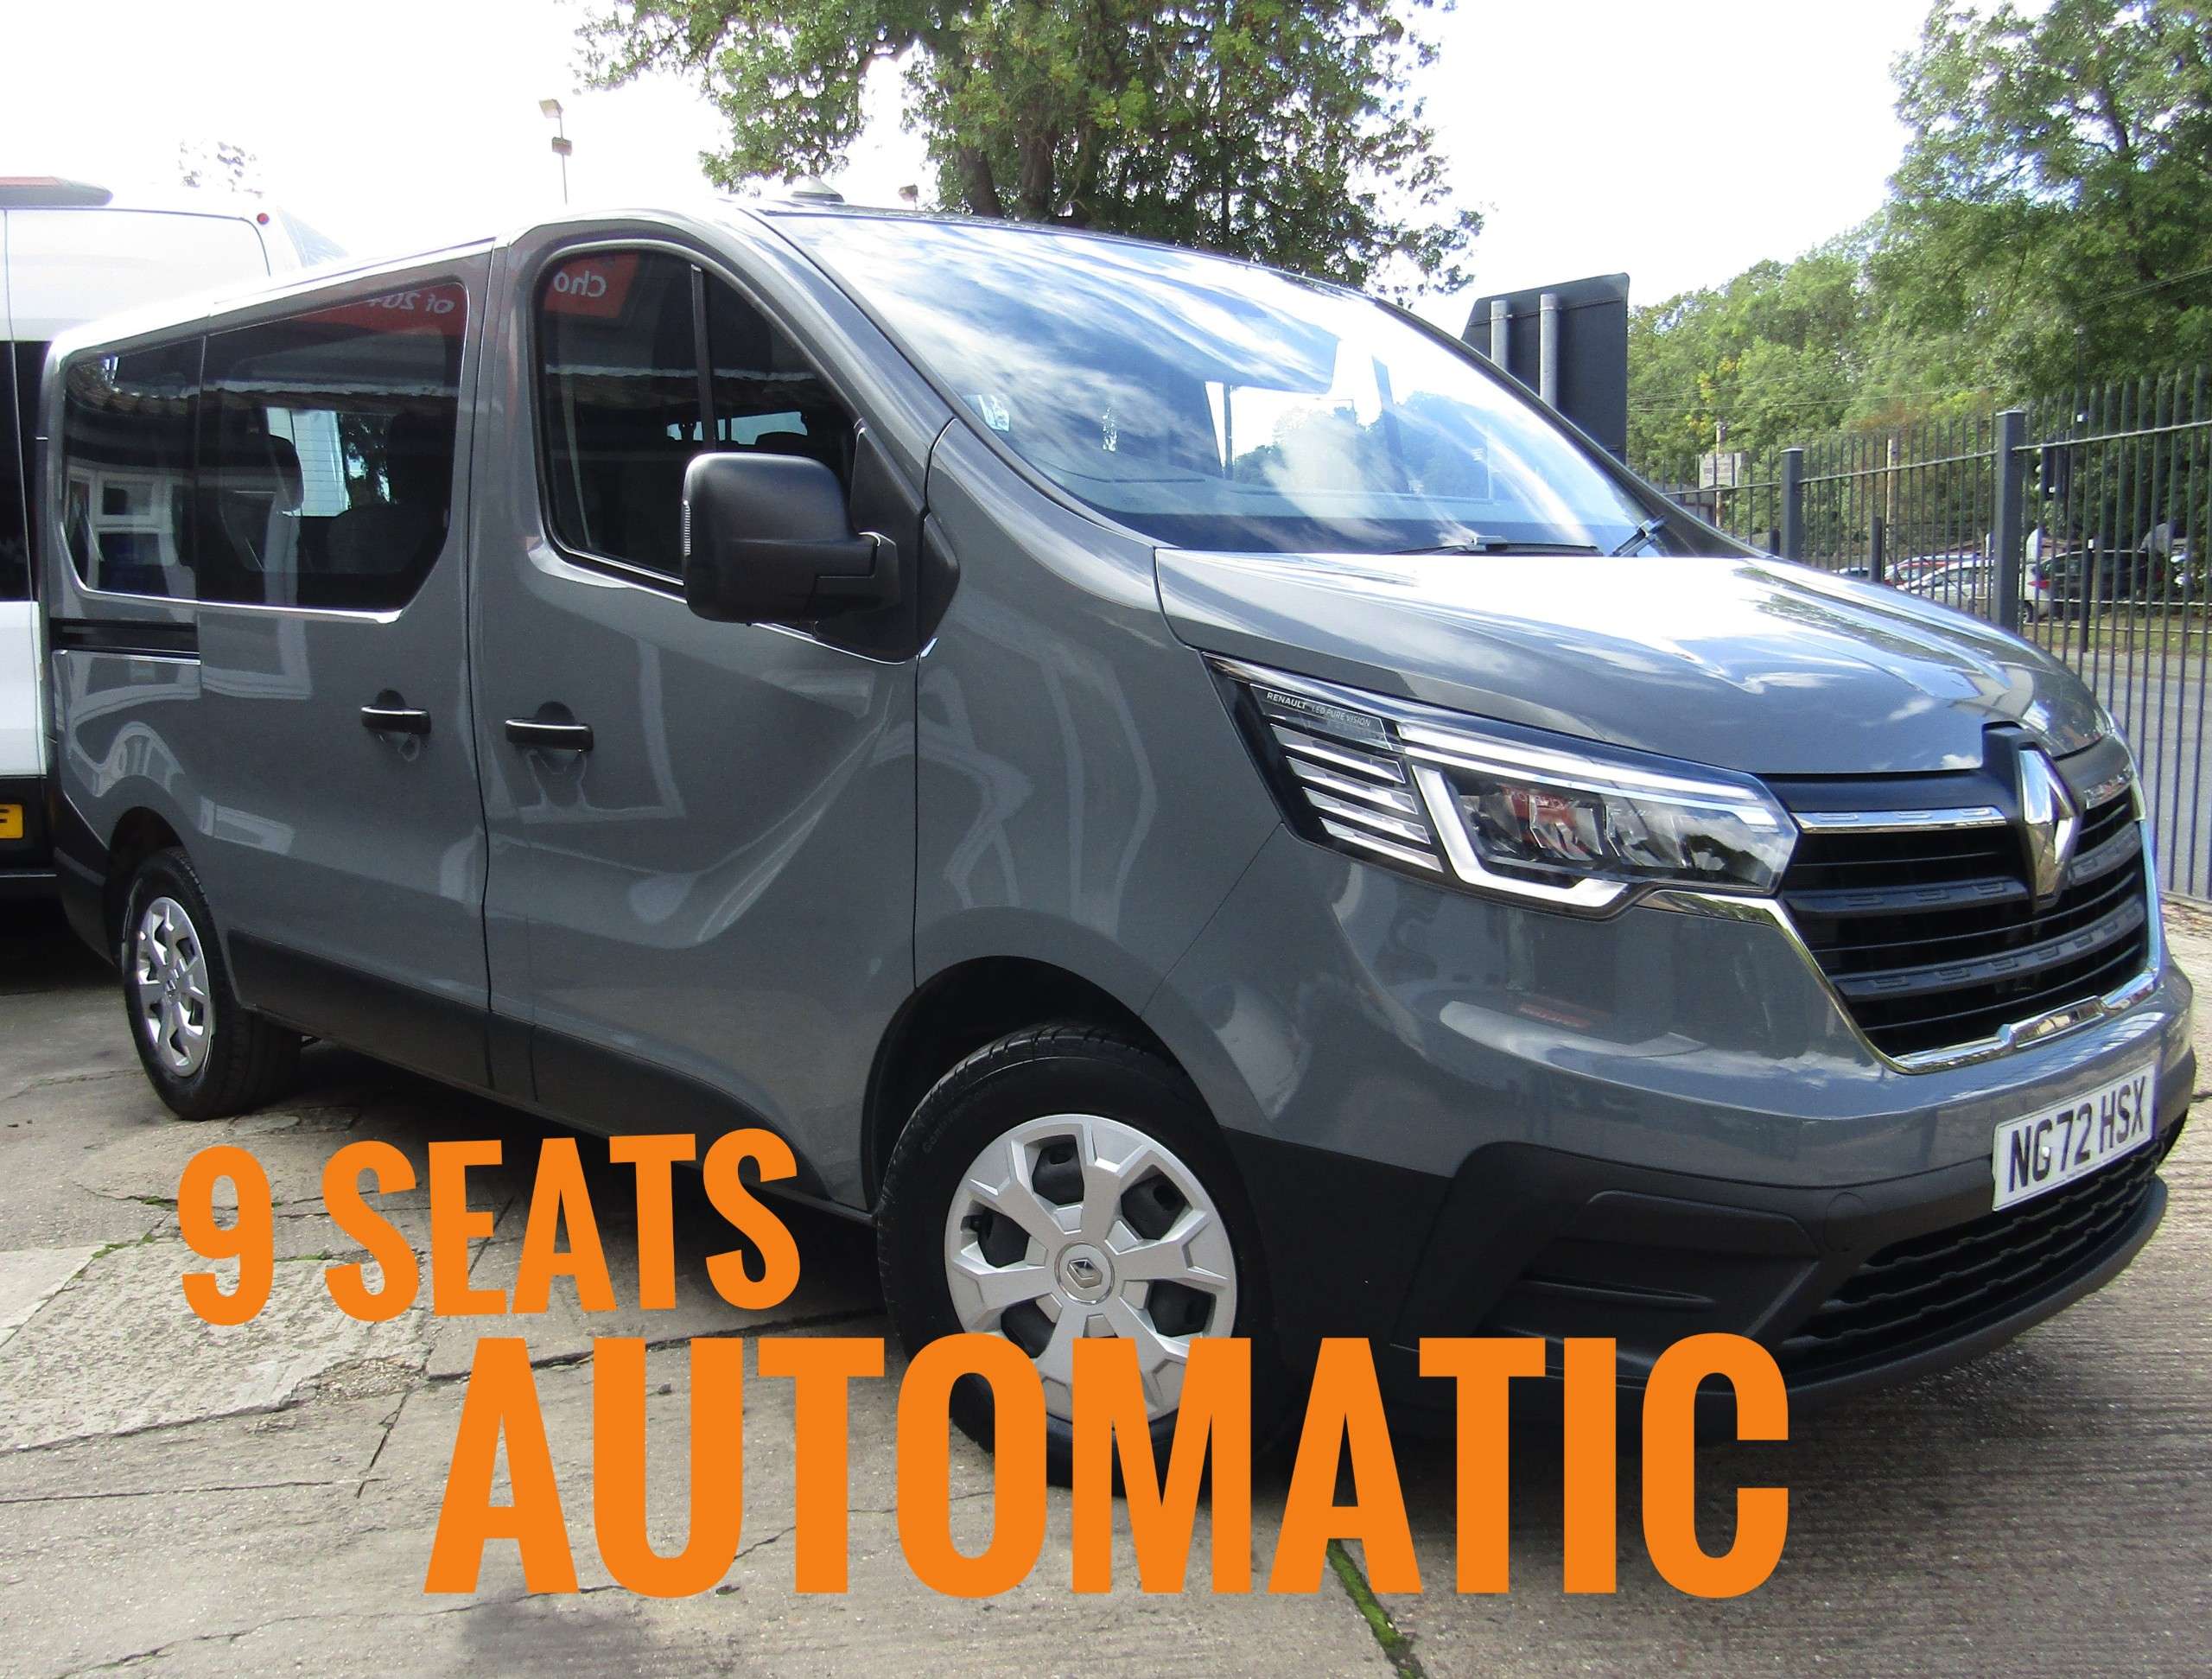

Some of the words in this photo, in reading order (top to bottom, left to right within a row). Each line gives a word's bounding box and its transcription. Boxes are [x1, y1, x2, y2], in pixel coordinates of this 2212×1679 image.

[1266, 691, 1307, 709] RENAULT
[1311, 705, 1325, 715] LED
[1326, 709, 1345, 721] PURE
[1345, 715, 1371, 727] VISION
[2008, 1102, 2093, 1193] NG72
[2099, 1075, 2146, 1154] HSX
